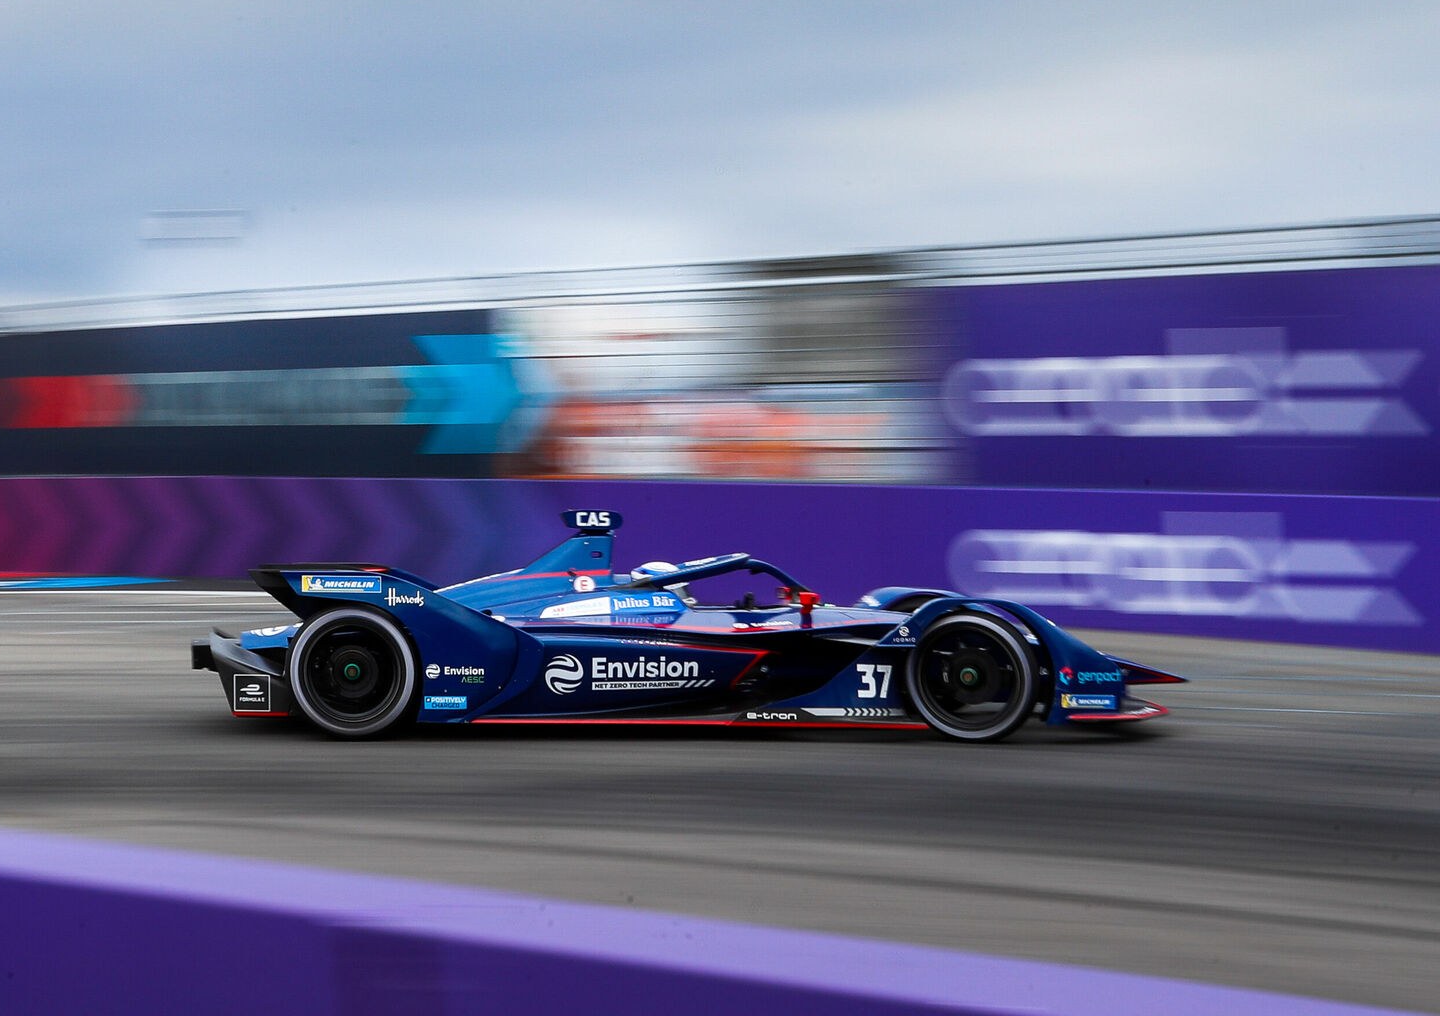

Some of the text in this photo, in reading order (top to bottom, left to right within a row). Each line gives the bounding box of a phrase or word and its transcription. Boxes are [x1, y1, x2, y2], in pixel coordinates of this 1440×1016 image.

[575, 511, 611, 527] CAS
[324, 580, 375, 588] MICHELIN
[384, 587, 424, 607] Harrods
[612, 597, 650, 611] Julius
[651, 595, 677, 607] Bär
[444, 666, 485, 676] Envision
[592, 656, 700, 679] Envision
[856, 664, 893, 699] 37
[1077, 668, 1122, 684] genpact
[746, 711, 797, 720] e-tron
